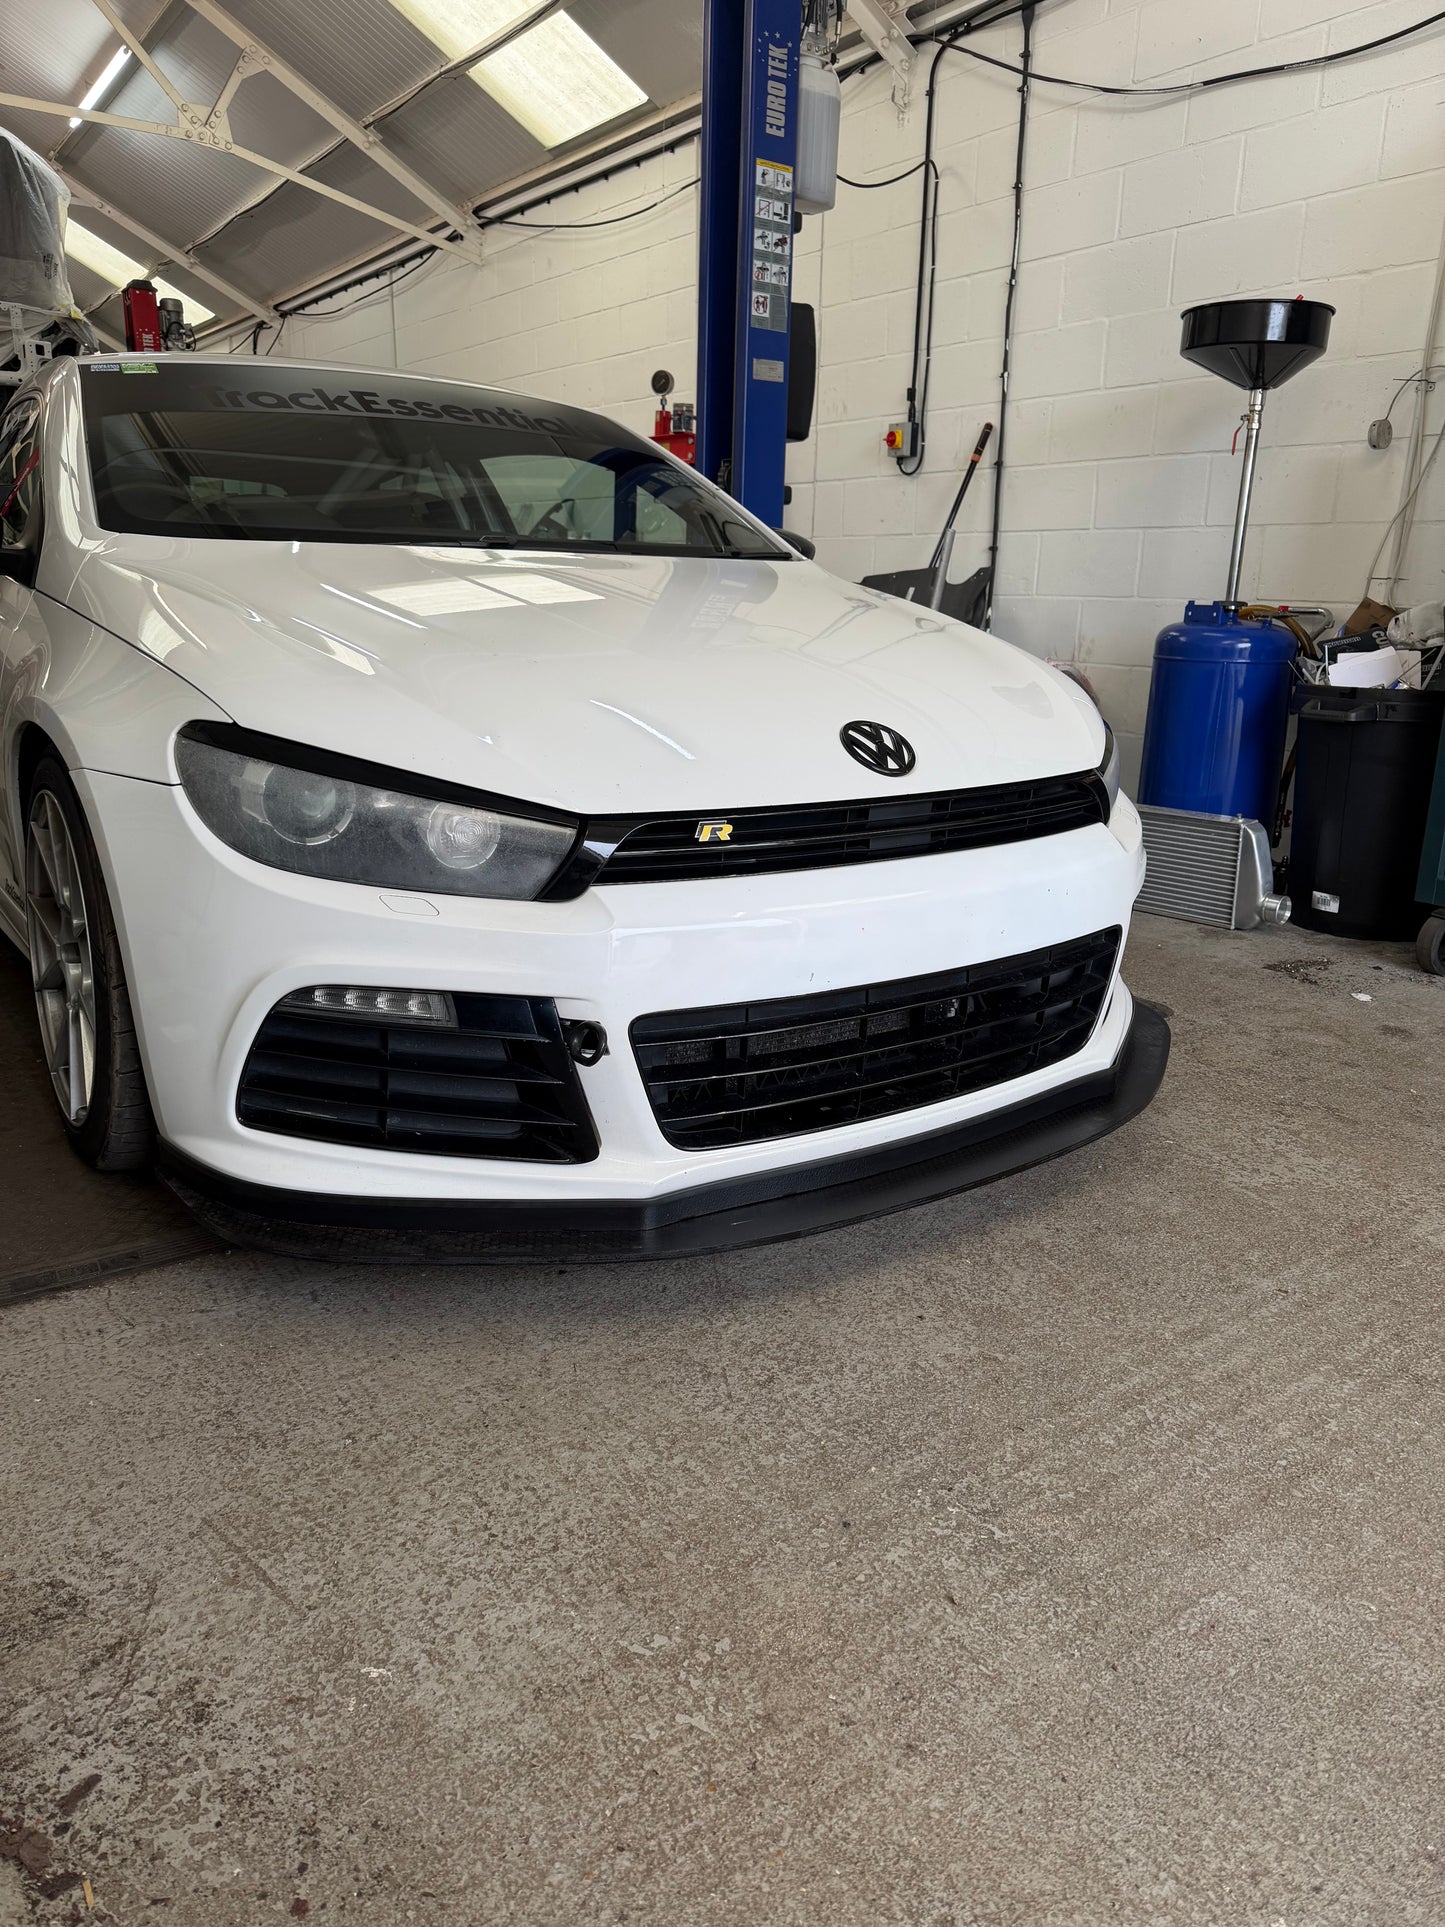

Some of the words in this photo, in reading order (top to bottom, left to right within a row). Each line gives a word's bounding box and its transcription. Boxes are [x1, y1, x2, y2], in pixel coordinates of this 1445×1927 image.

[768, 43, 788, 79] TEK
[765, 79, 787, 138] EURO
[695, 820, 733, 842] R
